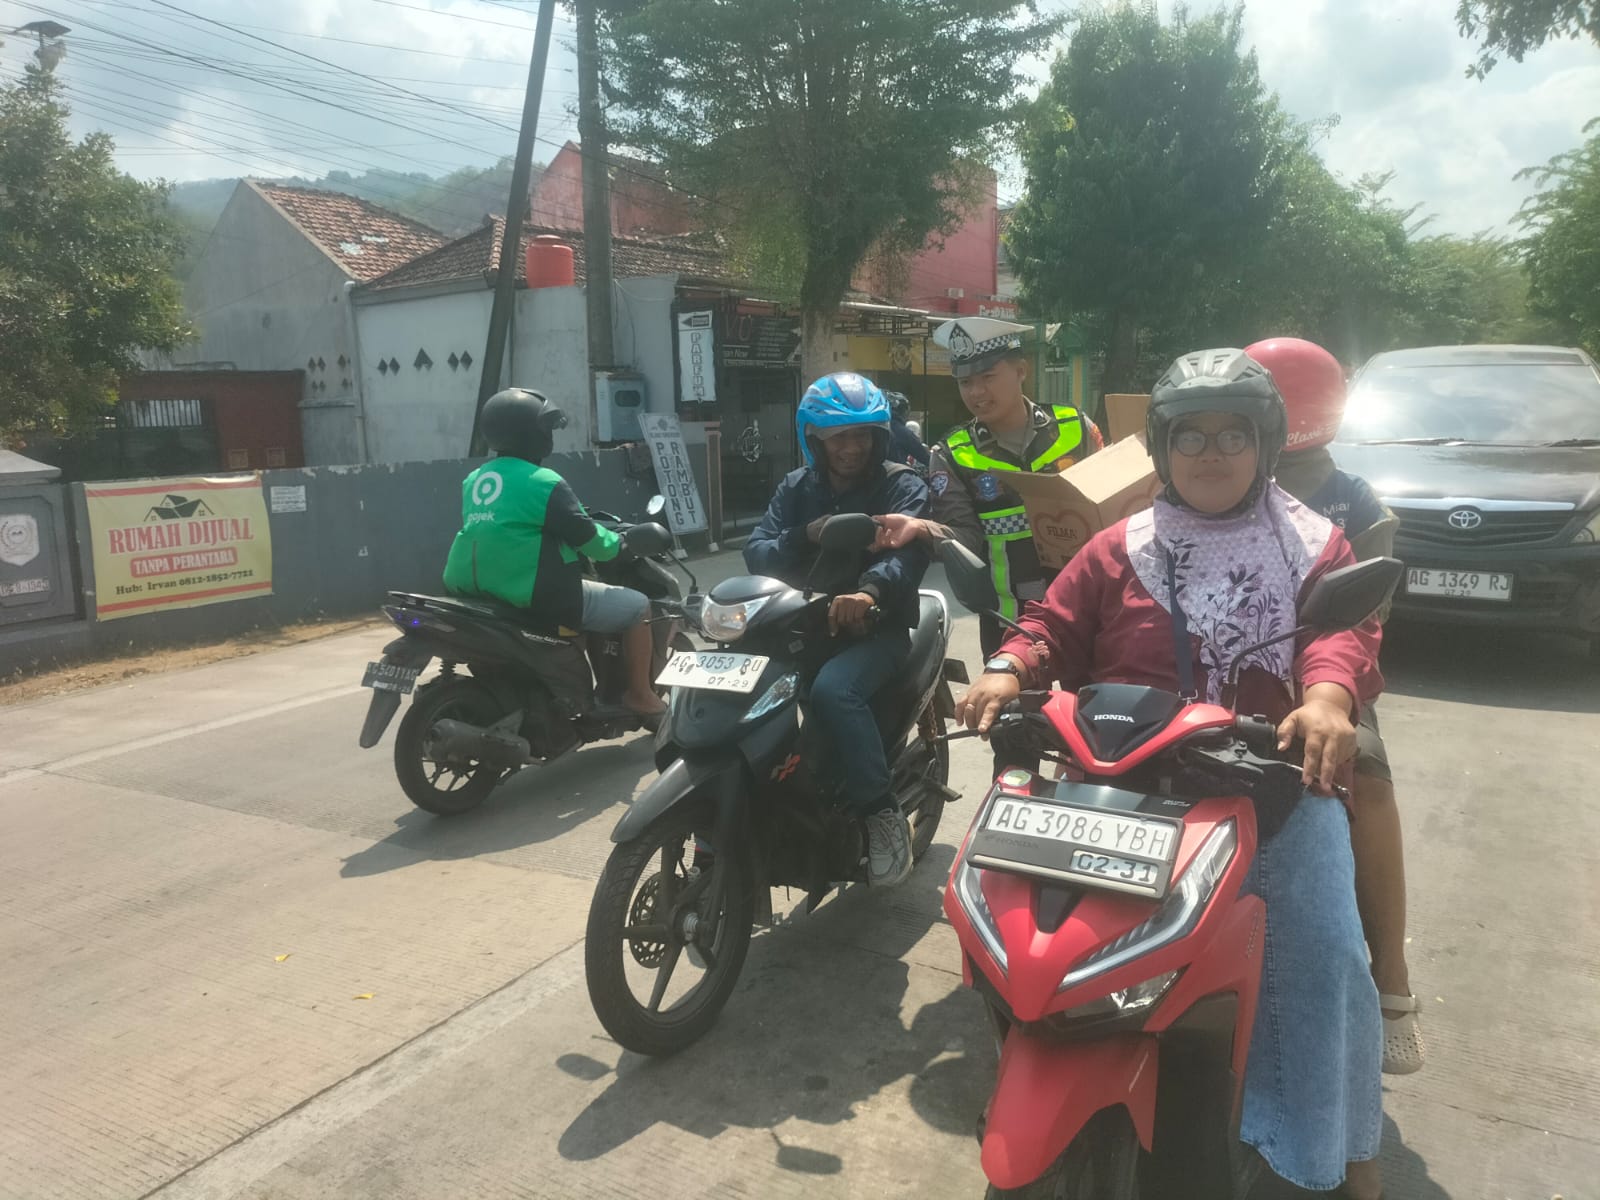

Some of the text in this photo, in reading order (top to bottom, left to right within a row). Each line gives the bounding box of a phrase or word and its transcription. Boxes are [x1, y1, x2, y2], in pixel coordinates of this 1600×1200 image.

[690, 332, 705, 396] PARFUM
[656, 442, 685, 525] POTONG
[670, 442, 697, 524] RAMBUT
[108, 517, 255, 555] RUMAH DIJUAL
[133, 550, 235, 575] TANPA PERANTARA
[116, 585, 143, 596] Hub:
[147, 579, 177, 591] Irvan
[1409, 571, 1512, 591] AG 1349 RJ
[670, 655, 691, 671] AG
[696, 655, 735, 670] 3053
[1093, 713, 1136, 723] HONDA
[996, 803, 1170, 857] AG 3986 YBH
